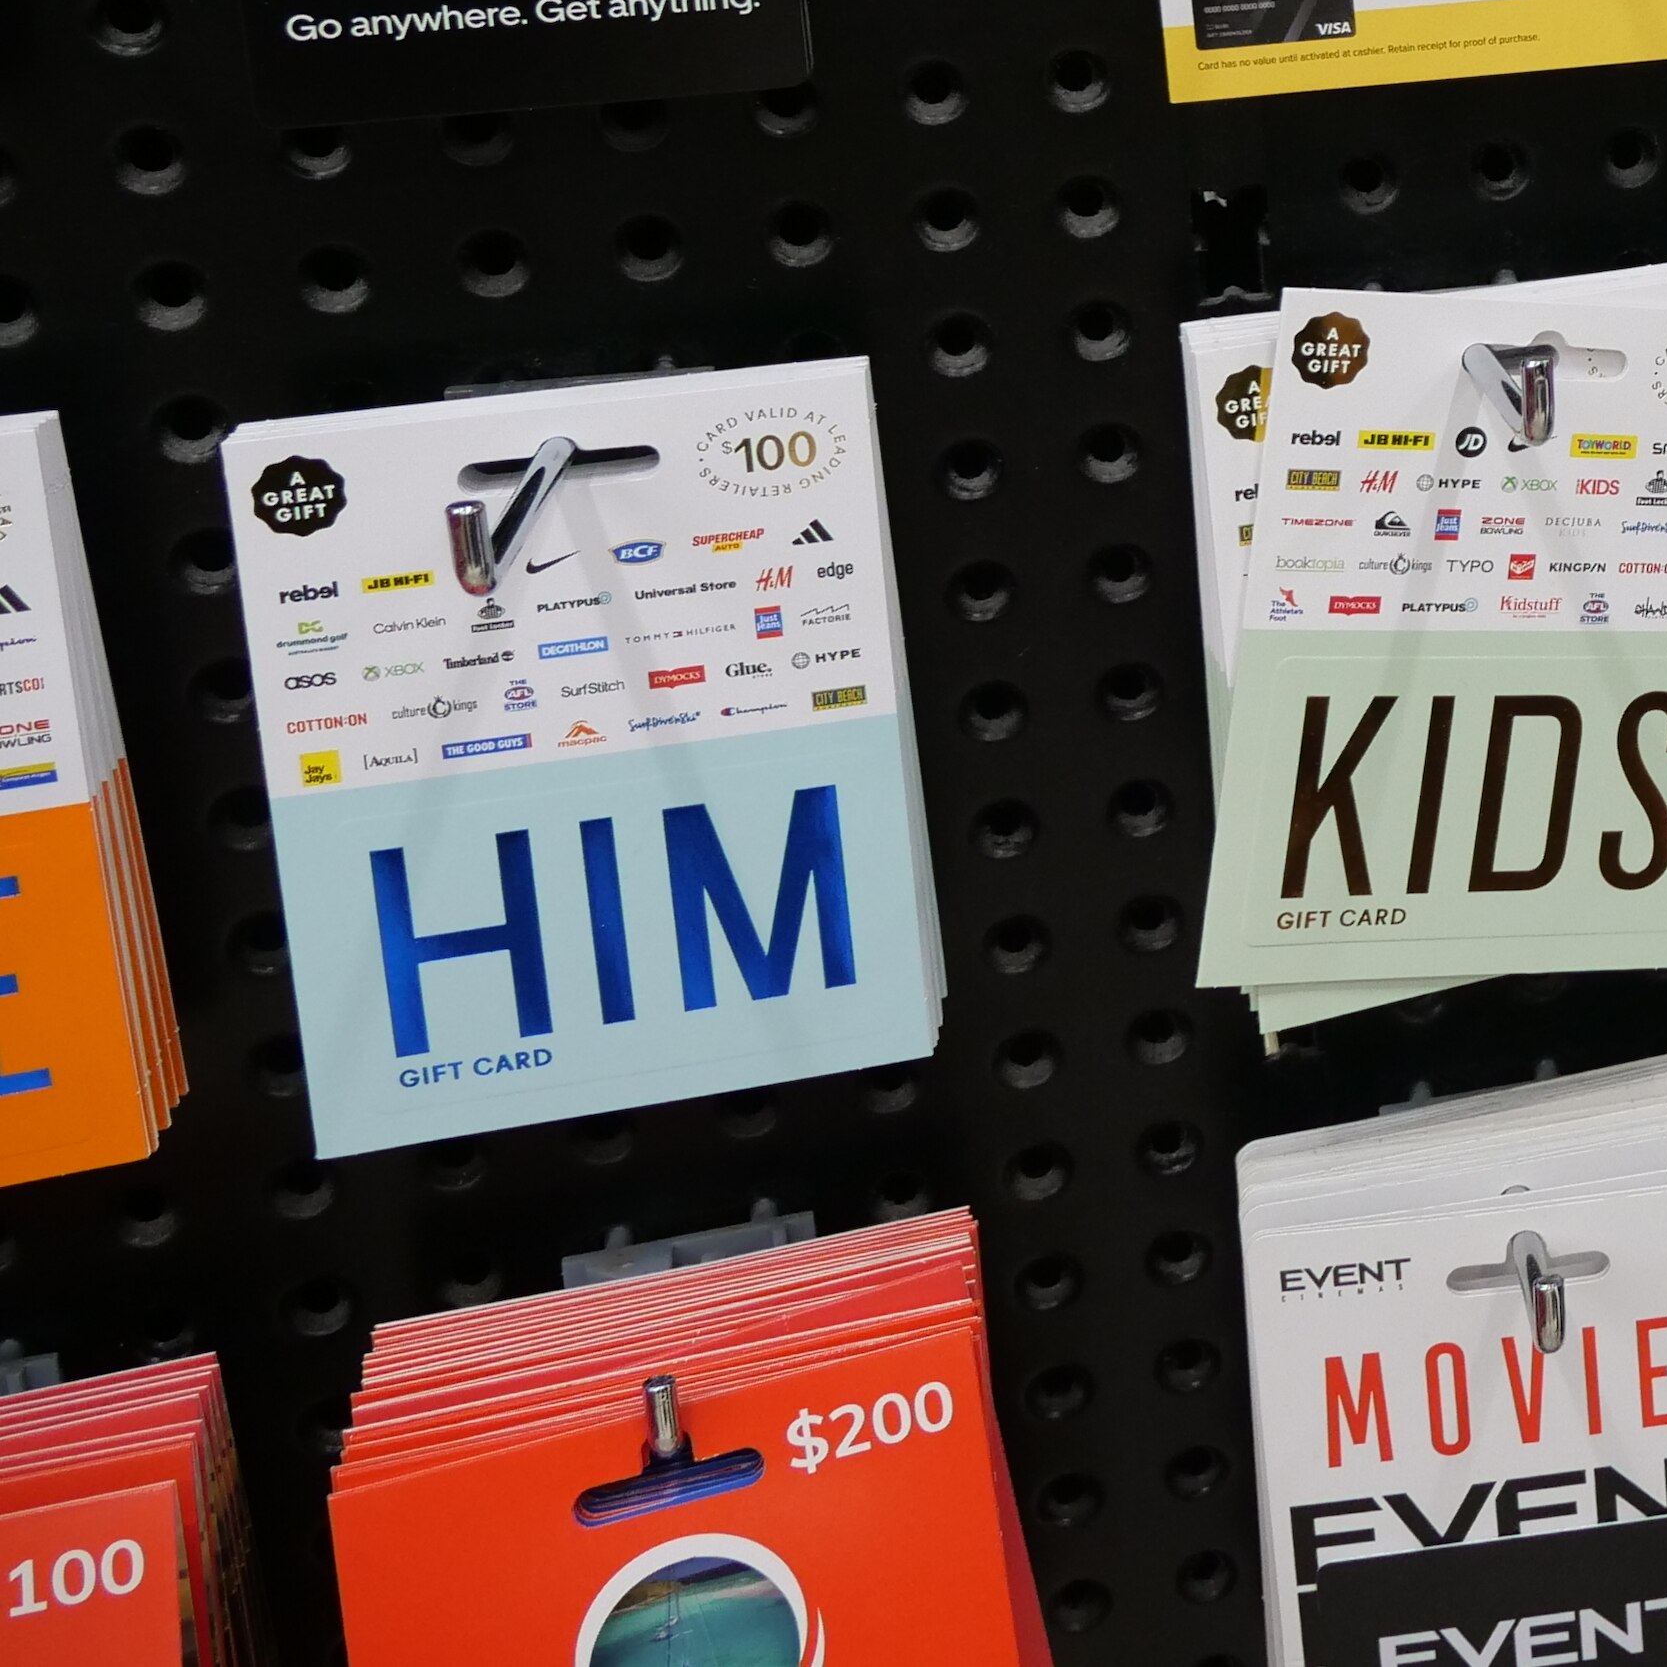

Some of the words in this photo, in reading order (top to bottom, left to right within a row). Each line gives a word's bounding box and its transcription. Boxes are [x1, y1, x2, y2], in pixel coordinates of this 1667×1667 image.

[285, 15, 343, 41] Go
[350, 1, 529, 41] anywhere.
[1291, 430, 1341, 446] rebel
[721, 430, 817, 475] $100
[1438, 478, 1481, 489] HYPE
[262, 485, 334, 507] GREAT
[276, 503, 326, 522] GIFT
[817, 562, 854, 580] edge
[1446, 559, 1494, 573] TYPO
[368, 577, 390, 590] JB
[394, 573, 429, 587] HI-FI
[279, 580, 339, 605] rebel
[537, 597, 599, 612] PLATYPUS
[541, 640, 605, 657] DECATHLON
[815, 648, 861, 663] HYPE
[284, 672, 337, 690] asos
[286, 712, 368, 734] COTTON:ON
[369, 784, 856, 1058] HIM
[399, 1060, 464, 1089] GIFT
[473, 1048, 554, 1076] CARD
[1280, 1258, 1411, 1292] EVENT
[786, 1381, 954, 1475] $200
